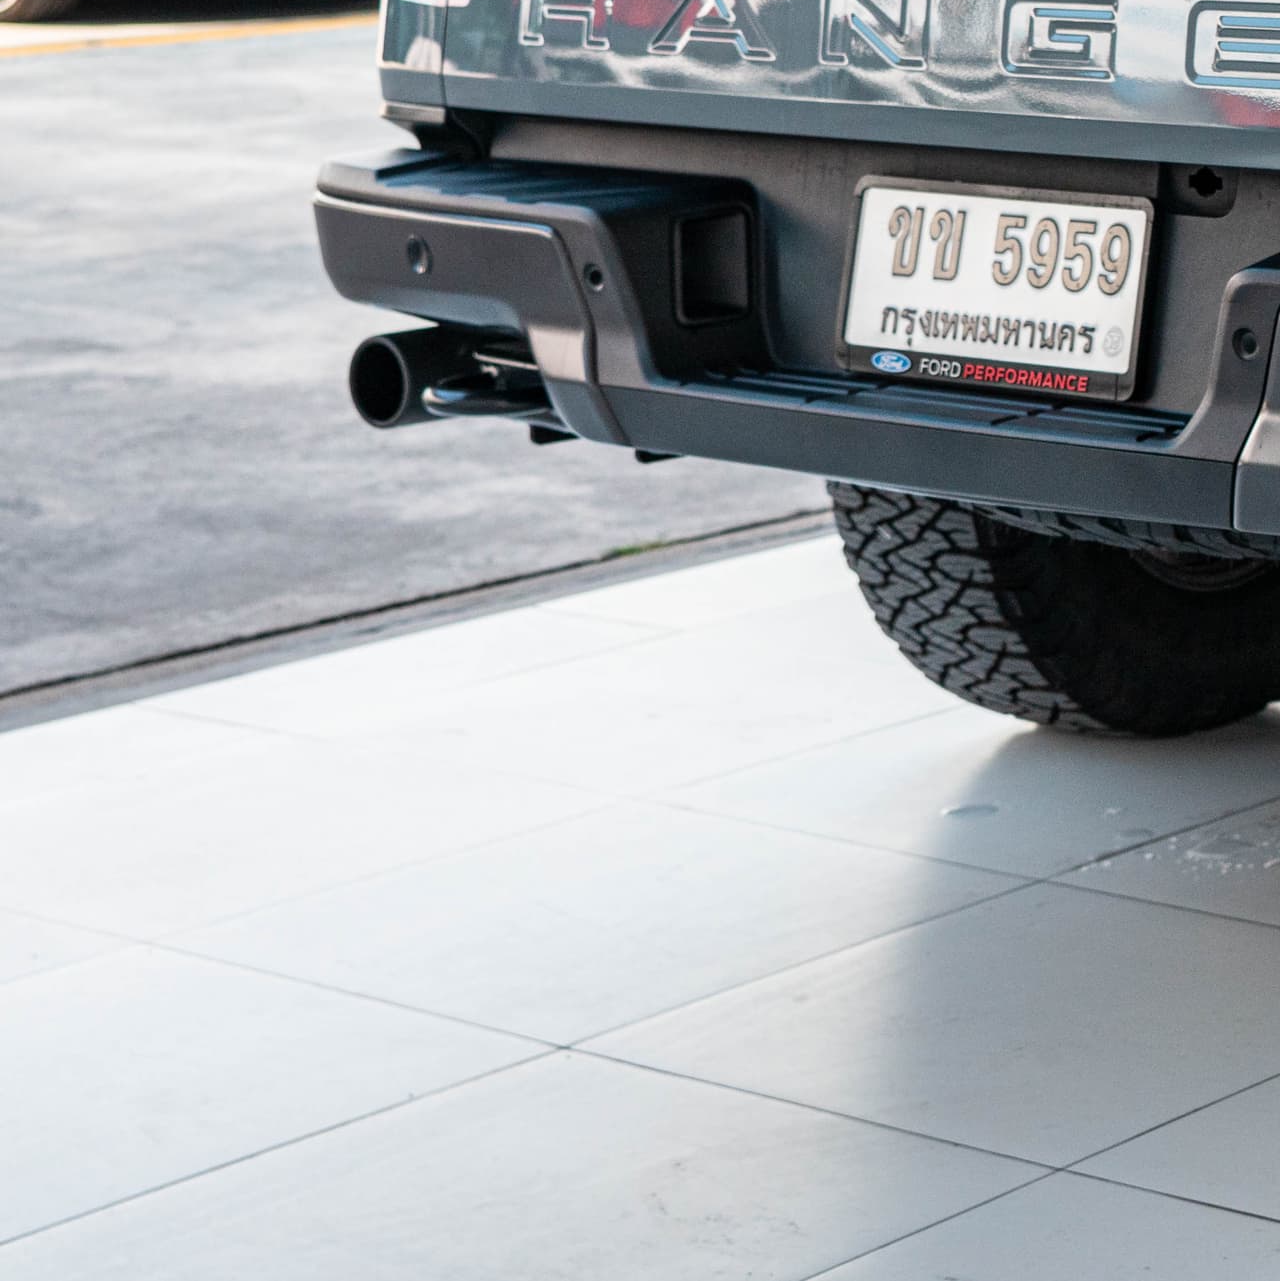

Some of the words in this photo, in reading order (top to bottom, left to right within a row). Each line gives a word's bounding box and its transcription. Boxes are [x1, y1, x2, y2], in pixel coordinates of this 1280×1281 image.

[991, 213, 1132, 297] 5959
[881, 304, 1097, 355] กรุงเทพมหานคร
[919, 358, 962, 378] FORD
[962, 363, 1089, 392] PERFORMANCE
